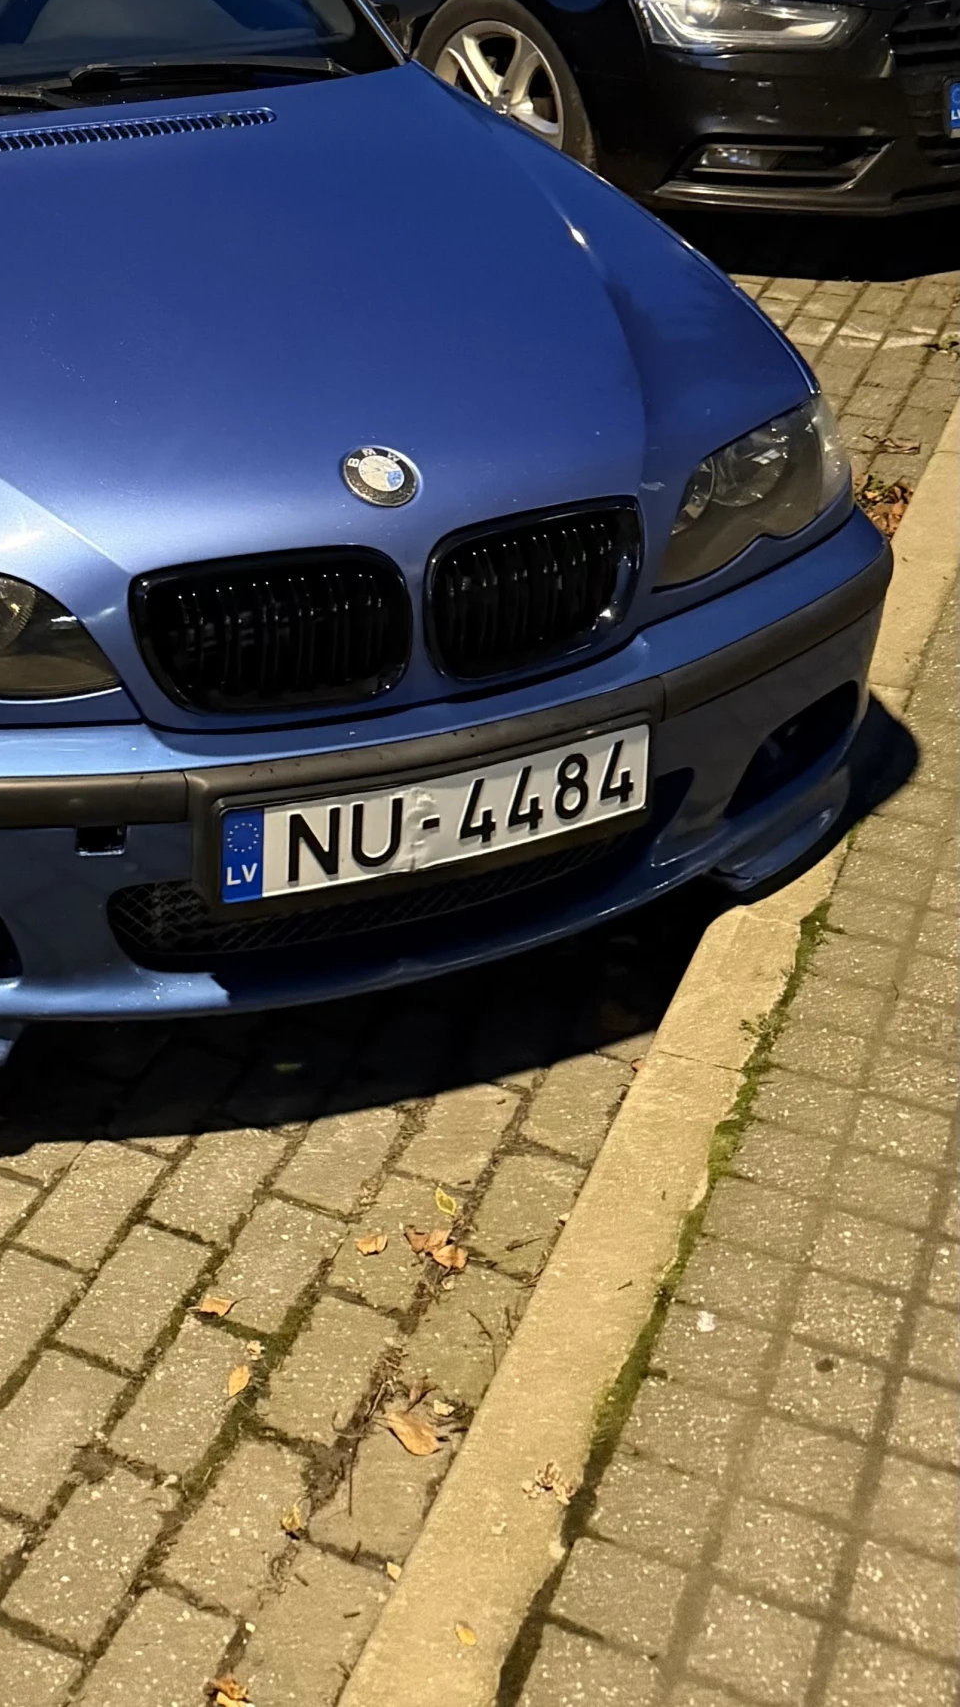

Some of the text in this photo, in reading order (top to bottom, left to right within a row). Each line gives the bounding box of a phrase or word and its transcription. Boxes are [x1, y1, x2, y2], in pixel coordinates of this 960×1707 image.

[347, 447, 401, 468] BMW
[287, 739, 635, 883] NU-4484
[226, 862, 258, 886] LV
